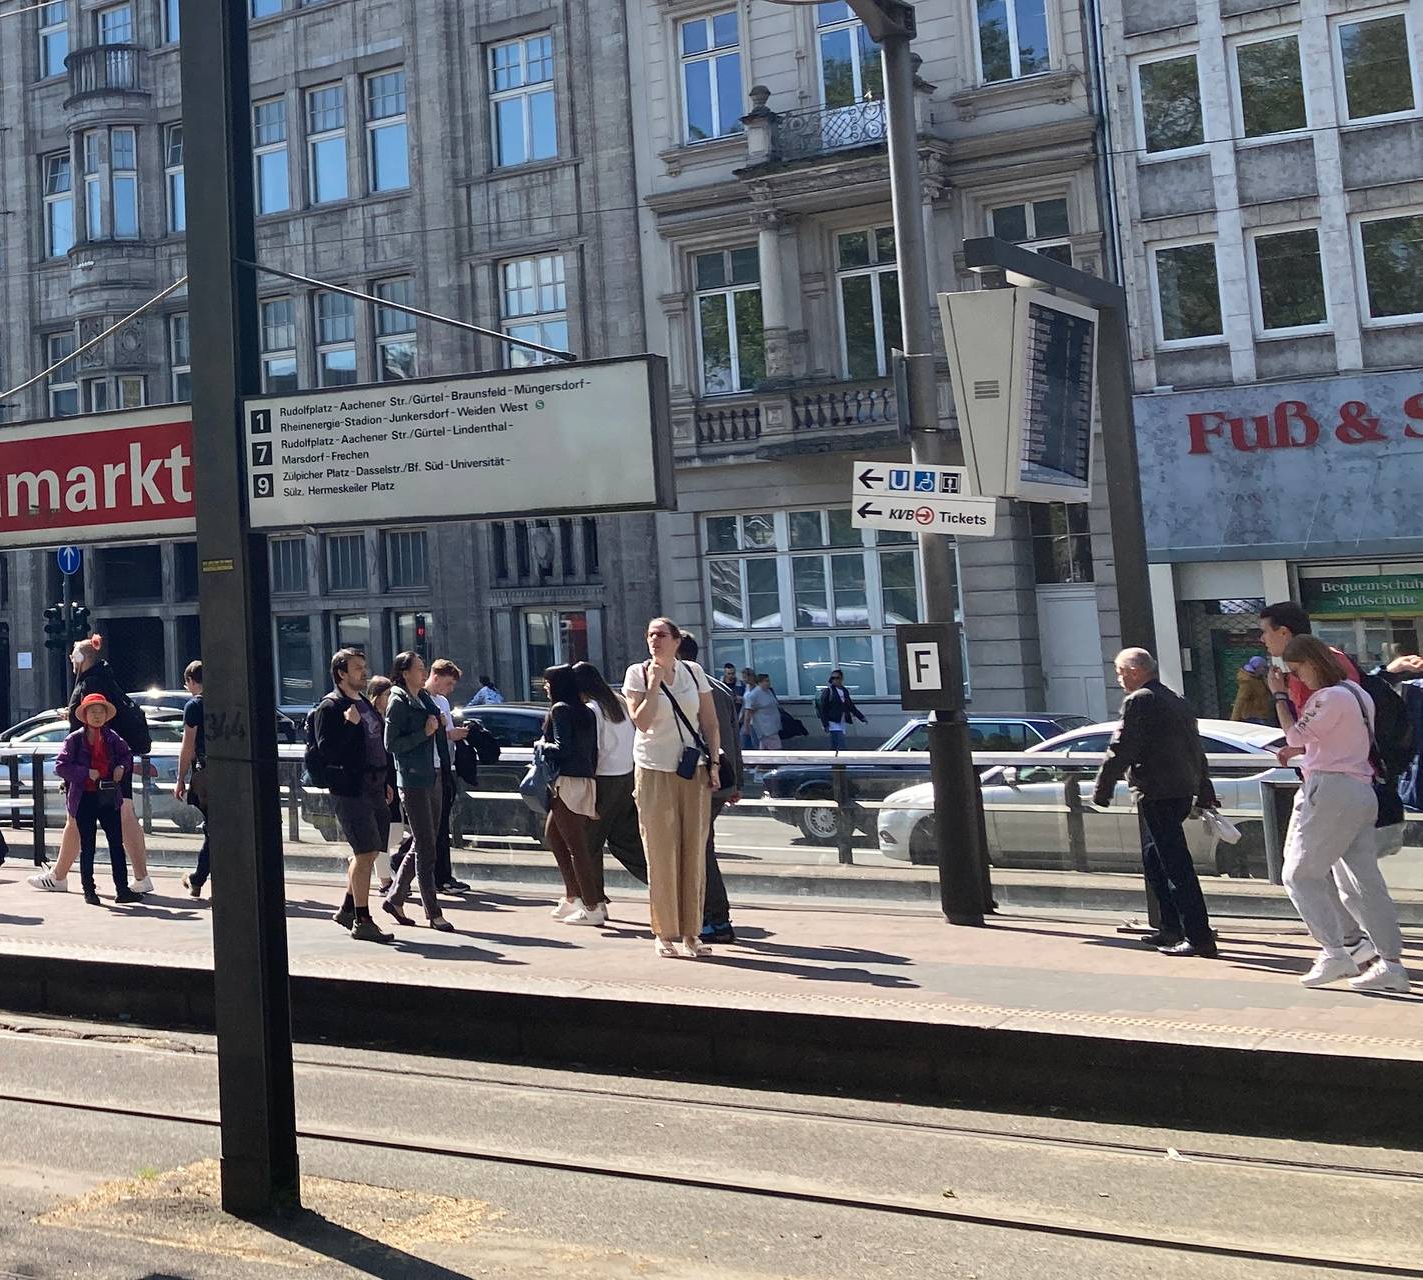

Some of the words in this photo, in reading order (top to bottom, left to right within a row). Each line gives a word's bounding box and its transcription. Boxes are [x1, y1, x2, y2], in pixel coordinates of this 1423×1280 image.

[500, 402, 529, 413] West
[256, 414, 265, 430] 1
[1186, 400, 1320, 455] Fuß
[1335, 401, 1388, 445] &
[257, 447, 267, 462] 7
[257, 478, 268, 495] 9
[308, 483, 368, 495] Hermeskeiler
[371, 481, 395, 491] Platz
[889, 509, 915, 521] KVB
[939, 511, 987, 526] Tickets
[1338, 594, 1417, 607] Maßschuhe
[914, 650, 931, 683] F
